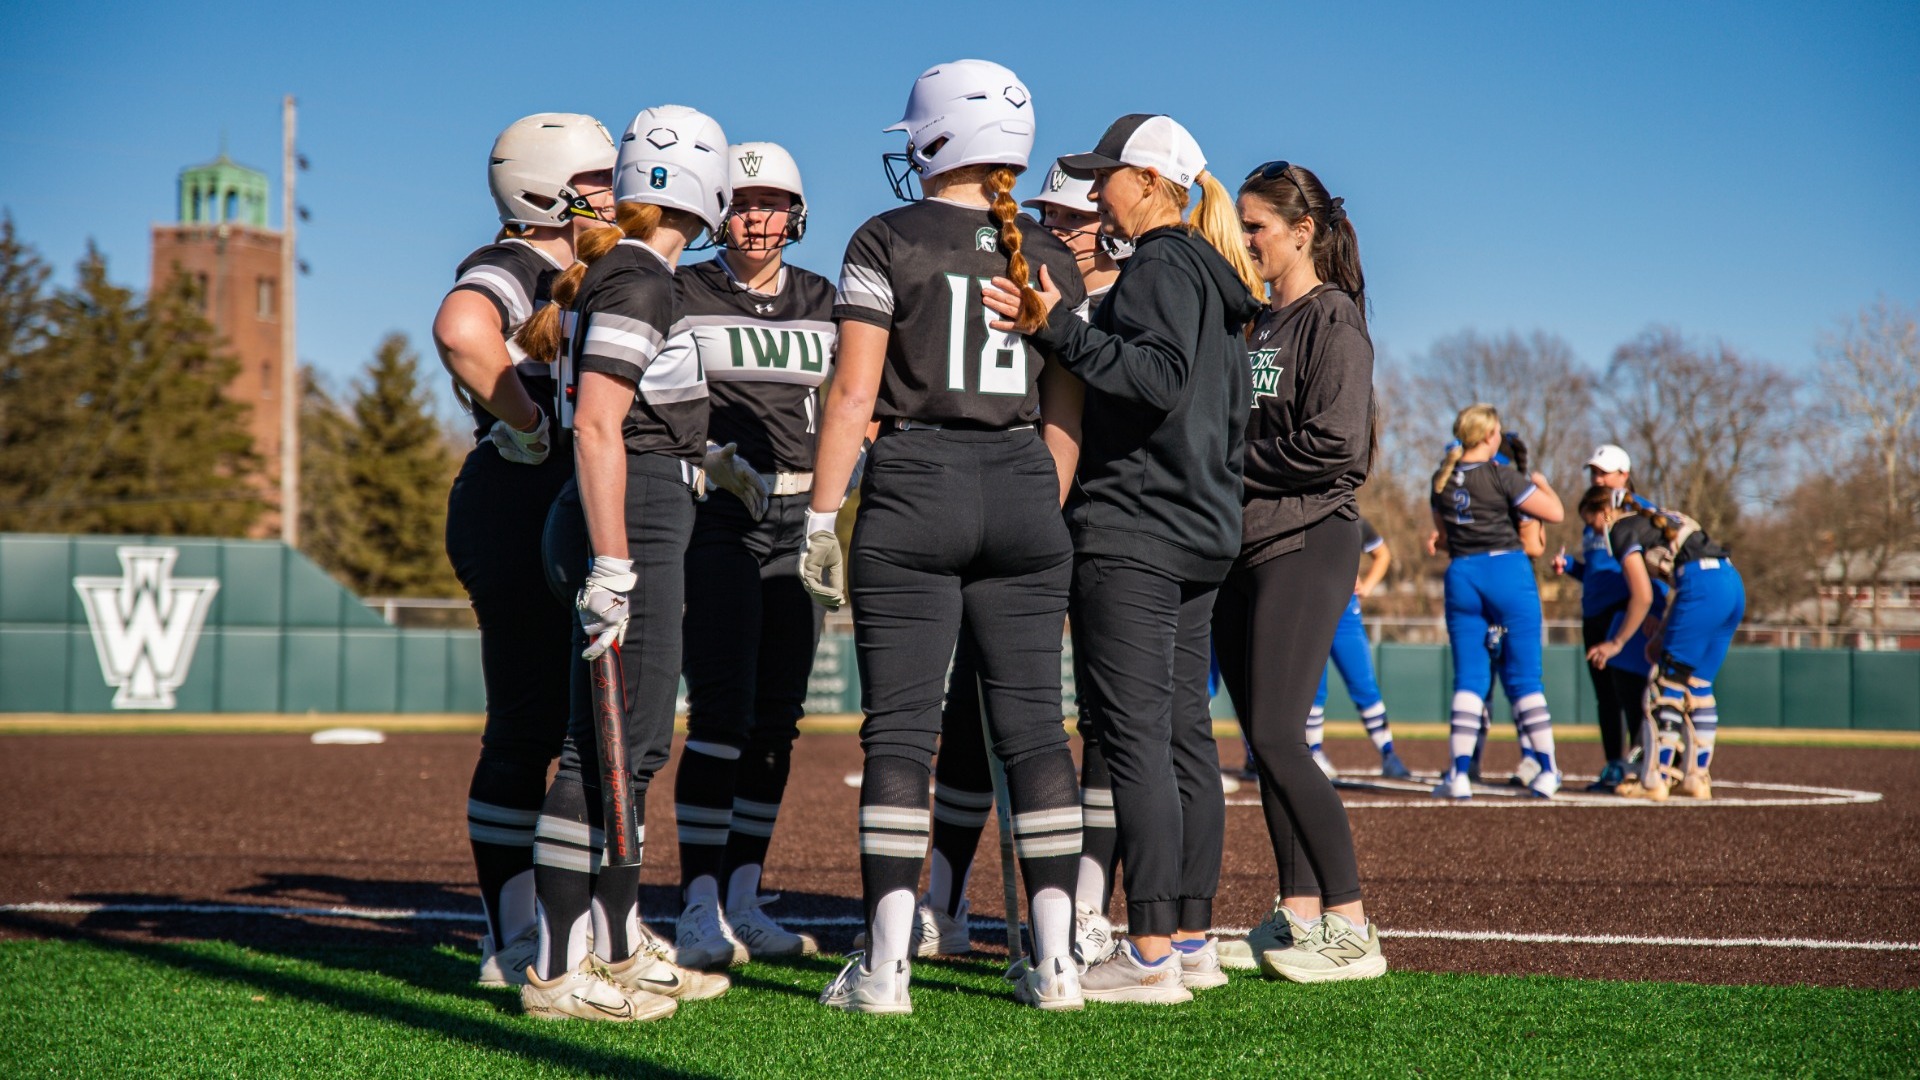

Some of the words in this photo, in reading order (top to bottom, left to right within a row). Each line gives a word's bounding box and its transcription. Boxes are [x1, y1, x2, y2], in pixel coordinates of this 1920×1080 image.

[725, 326, 823, 373] IWU
[944, 272, 1035, 396] 18
[1452, 488, 1475, 525] 2
[611, 769, 627, 857] ADVANCED
